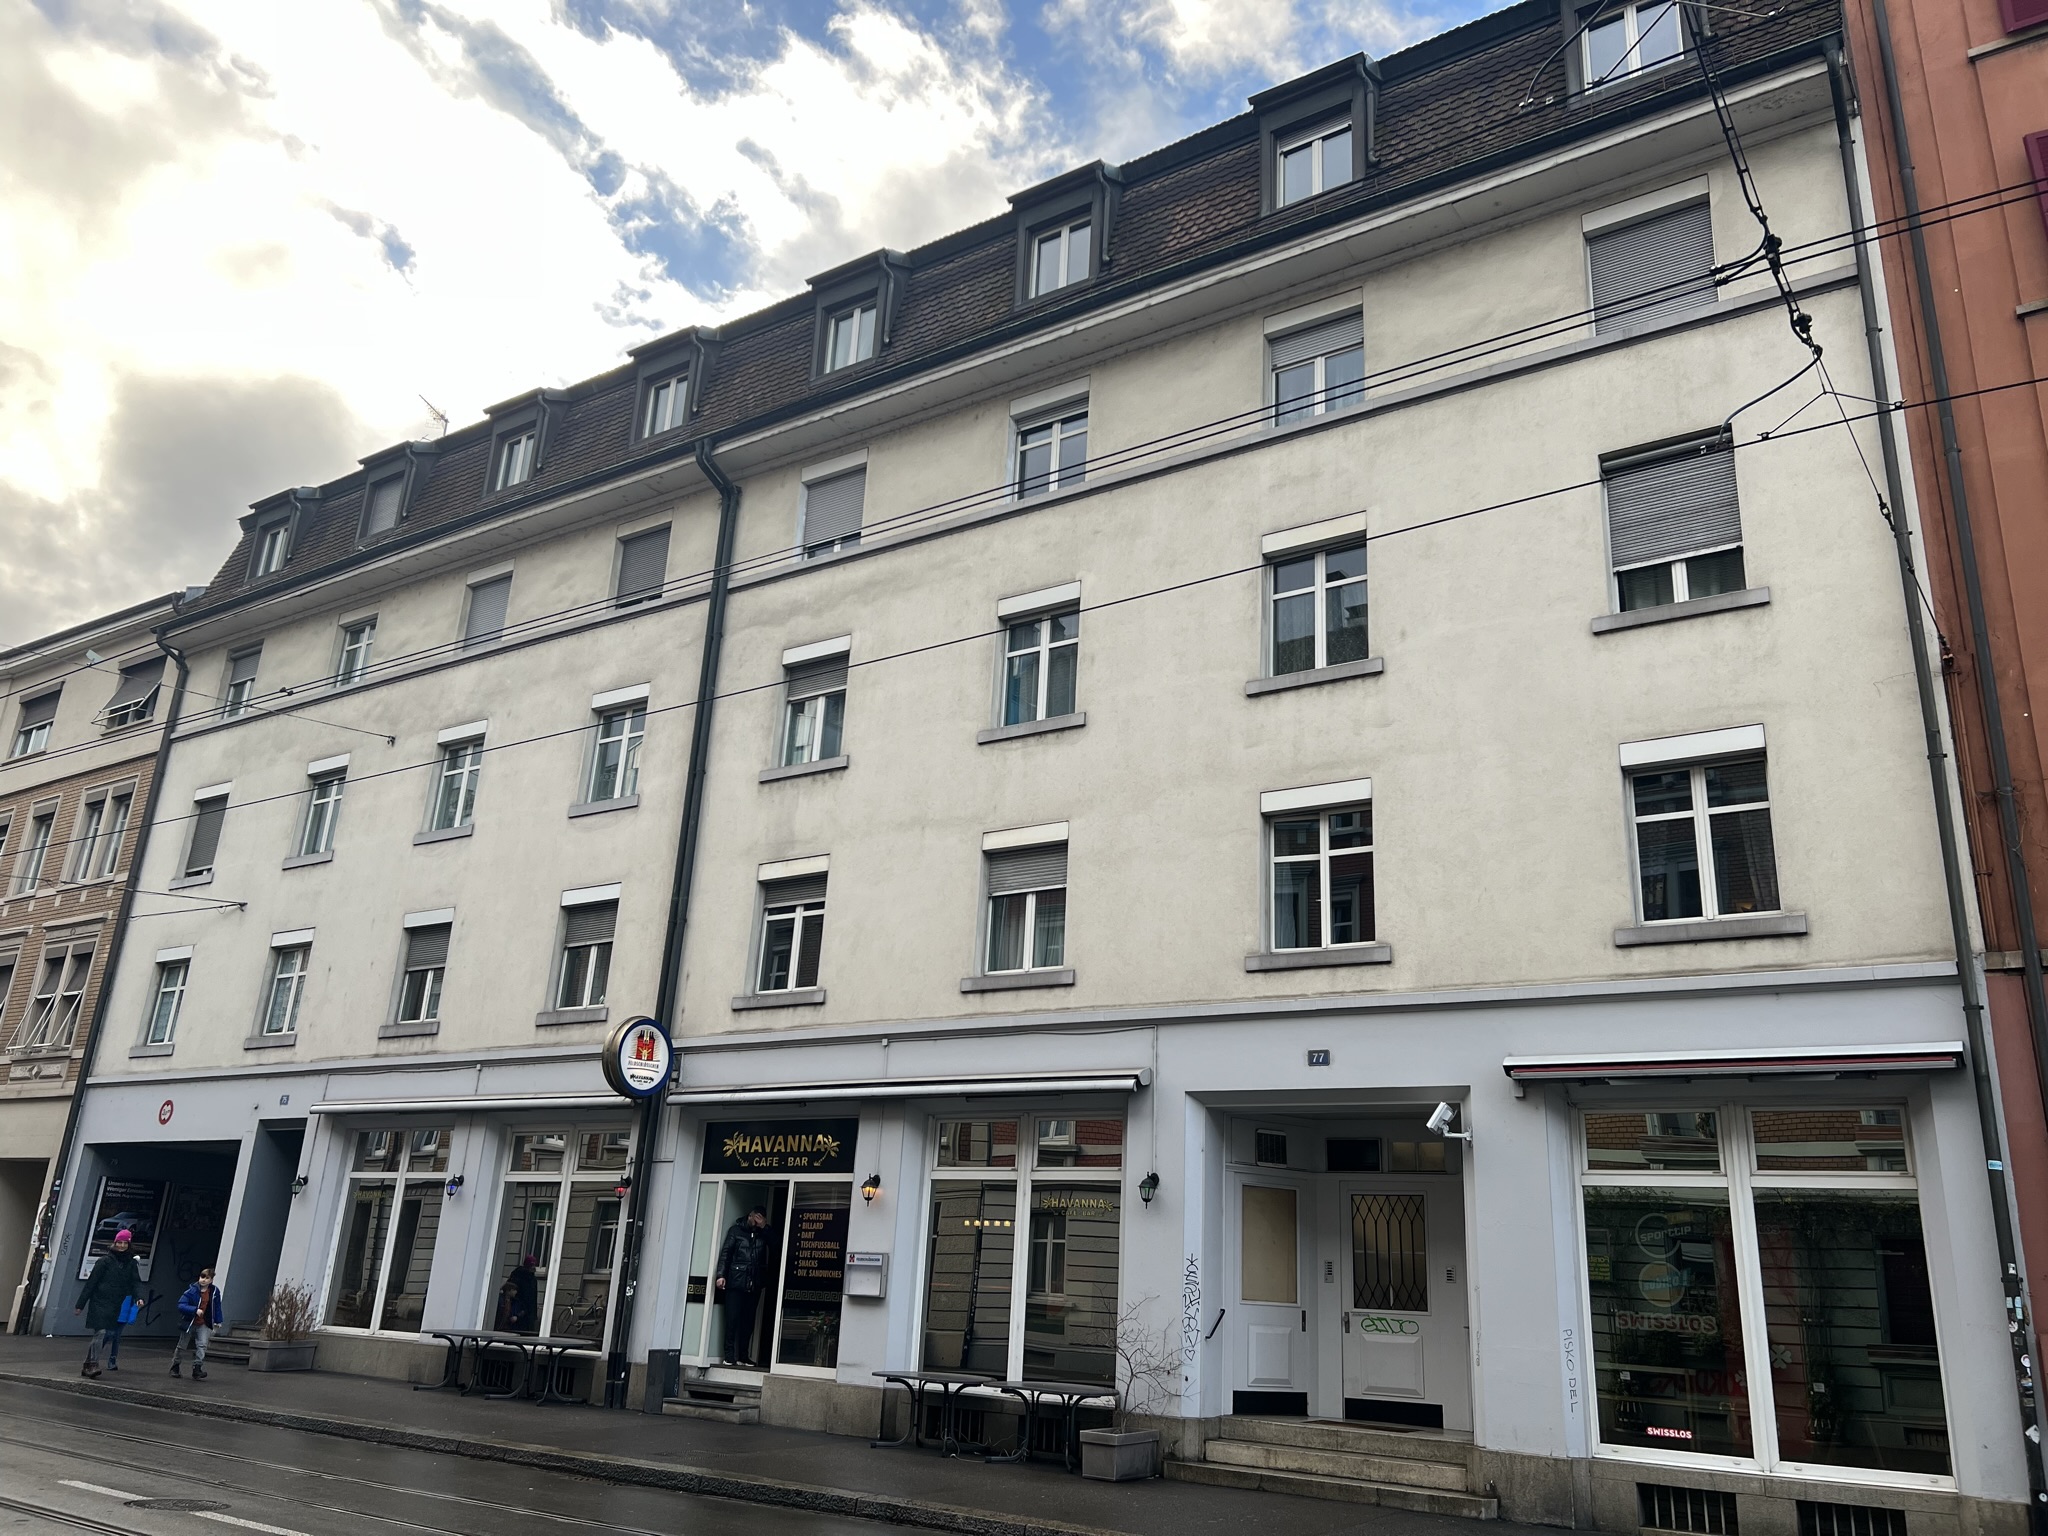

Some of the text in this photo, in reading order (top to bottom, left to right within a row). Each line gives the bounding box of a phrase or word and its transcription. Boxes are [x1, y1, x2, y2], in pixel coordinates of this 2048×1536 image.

[1313, 1053, 1324, 1062] 77
[738, 1134, 826, 1153] HAVANNA
[787, 1156, 809, 1167] BAR
[1051, 1198, 1105, 1209] HAVANNA
[803, 1212, 833, 1221] SPORTSBAR
[802, 1222, 823, 1230] BILLARD
[801, 1231, 815, 1239] DART
[801, 1240, 840, 1250] TISCHFUSSBALL
[799, 1250, 838, 1259] LIVE FUSSBALL
[798, 1259, 818, 1267] SNACKS
[809, 1269, 842, 1278] SANDWICHES
[1617, 1312, 1717, 1333] SWISSLOS
[1646, 1427, 1692, 1439] SWISSLOS
